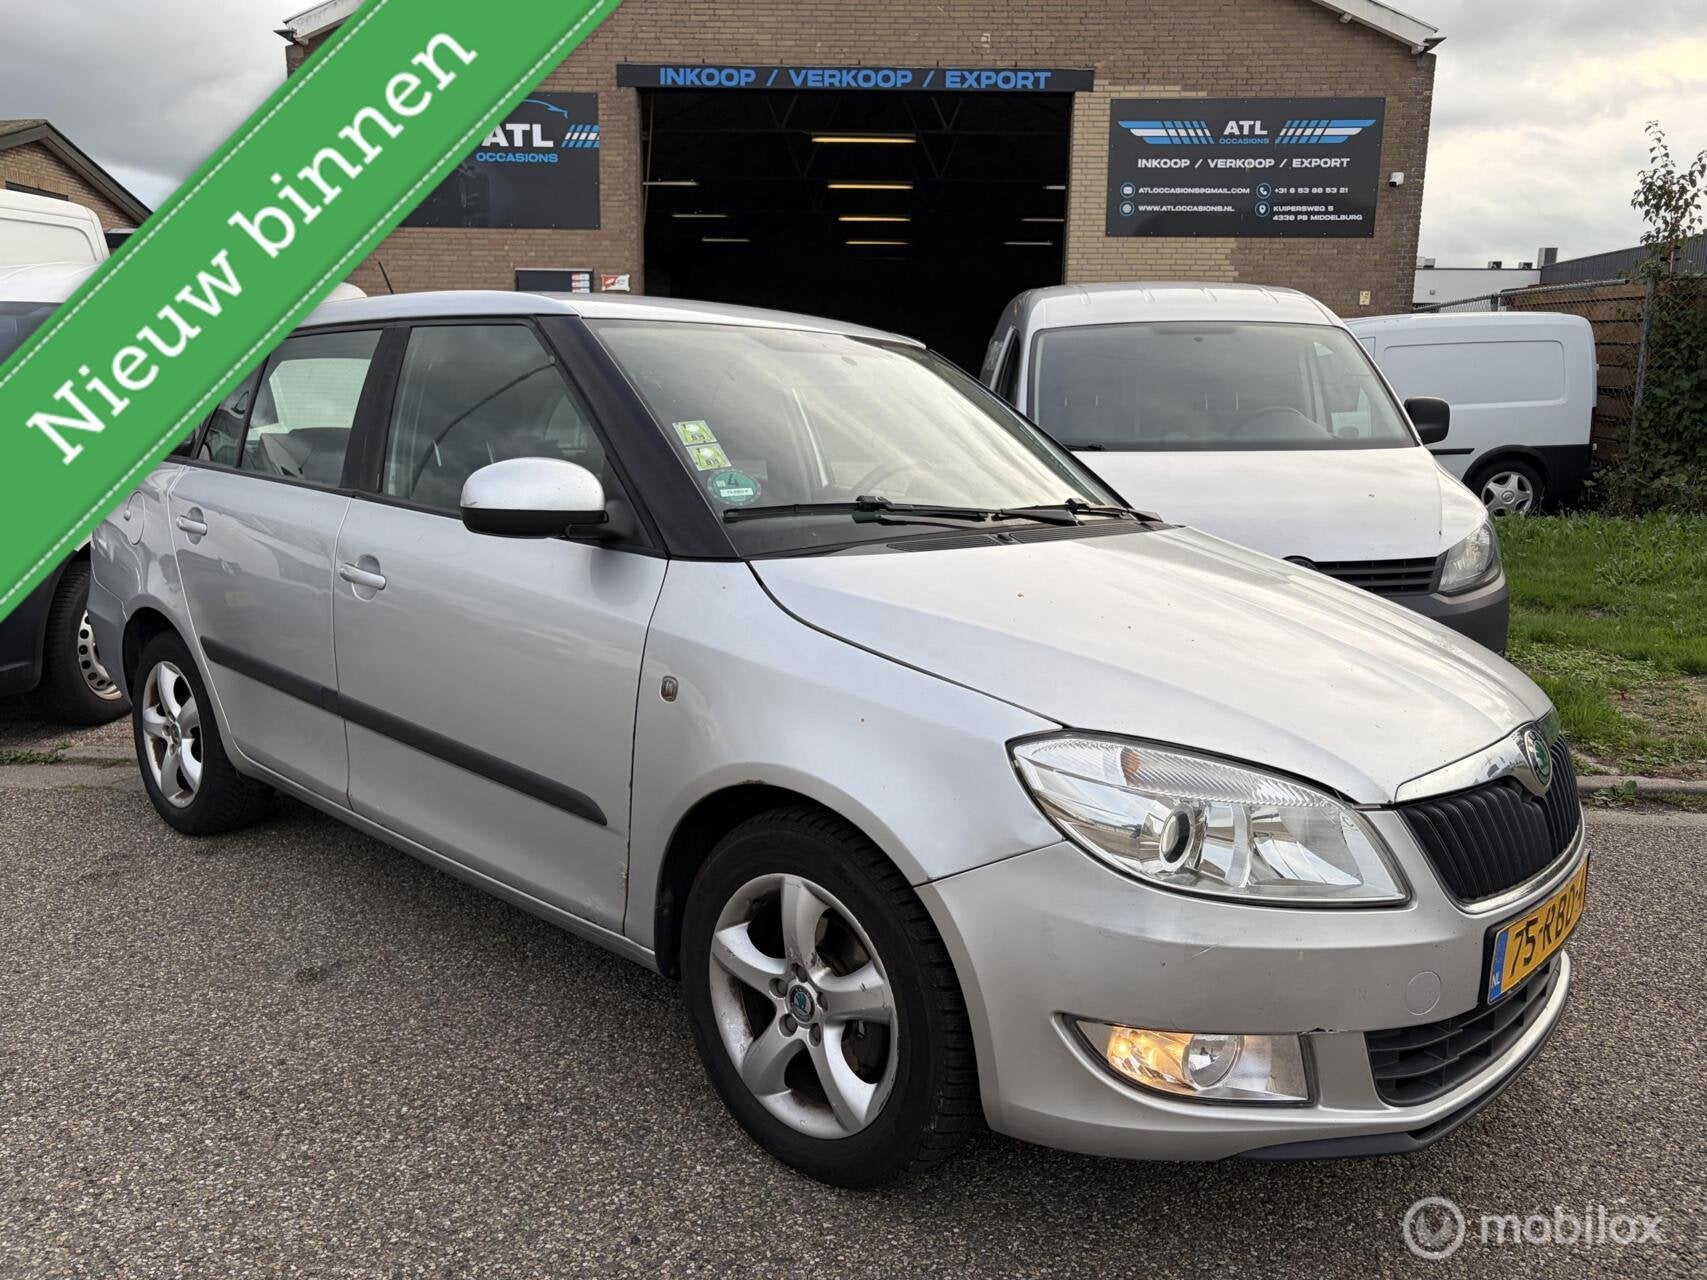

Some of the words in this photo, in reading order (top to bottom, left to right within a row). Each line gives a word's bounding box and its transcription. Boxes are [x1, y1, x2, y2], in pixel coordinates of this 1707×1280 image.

[659, 67, 757, 88] INKOOP
[767, 68, 779, 87] /
[789, 68, 913, 88] VERKOOP
[923, 70, 935, 88] /
[944, 70, 1051, 90] EXPORT
[481, 122, 554, 148] ATL
[1223, 120, 1268, 136] ATL
[1219, 137, 1269, 145] OCCASIONS
[475, 151, 559, 164] OCCASIONS
[1137, 158, 1191, 169] INKOOP
[1207, 158, 1275, 169] VERKOOP
[1291, 157, 1351, 168] EXPORT
[1491, 973, 1500, 988] NL
